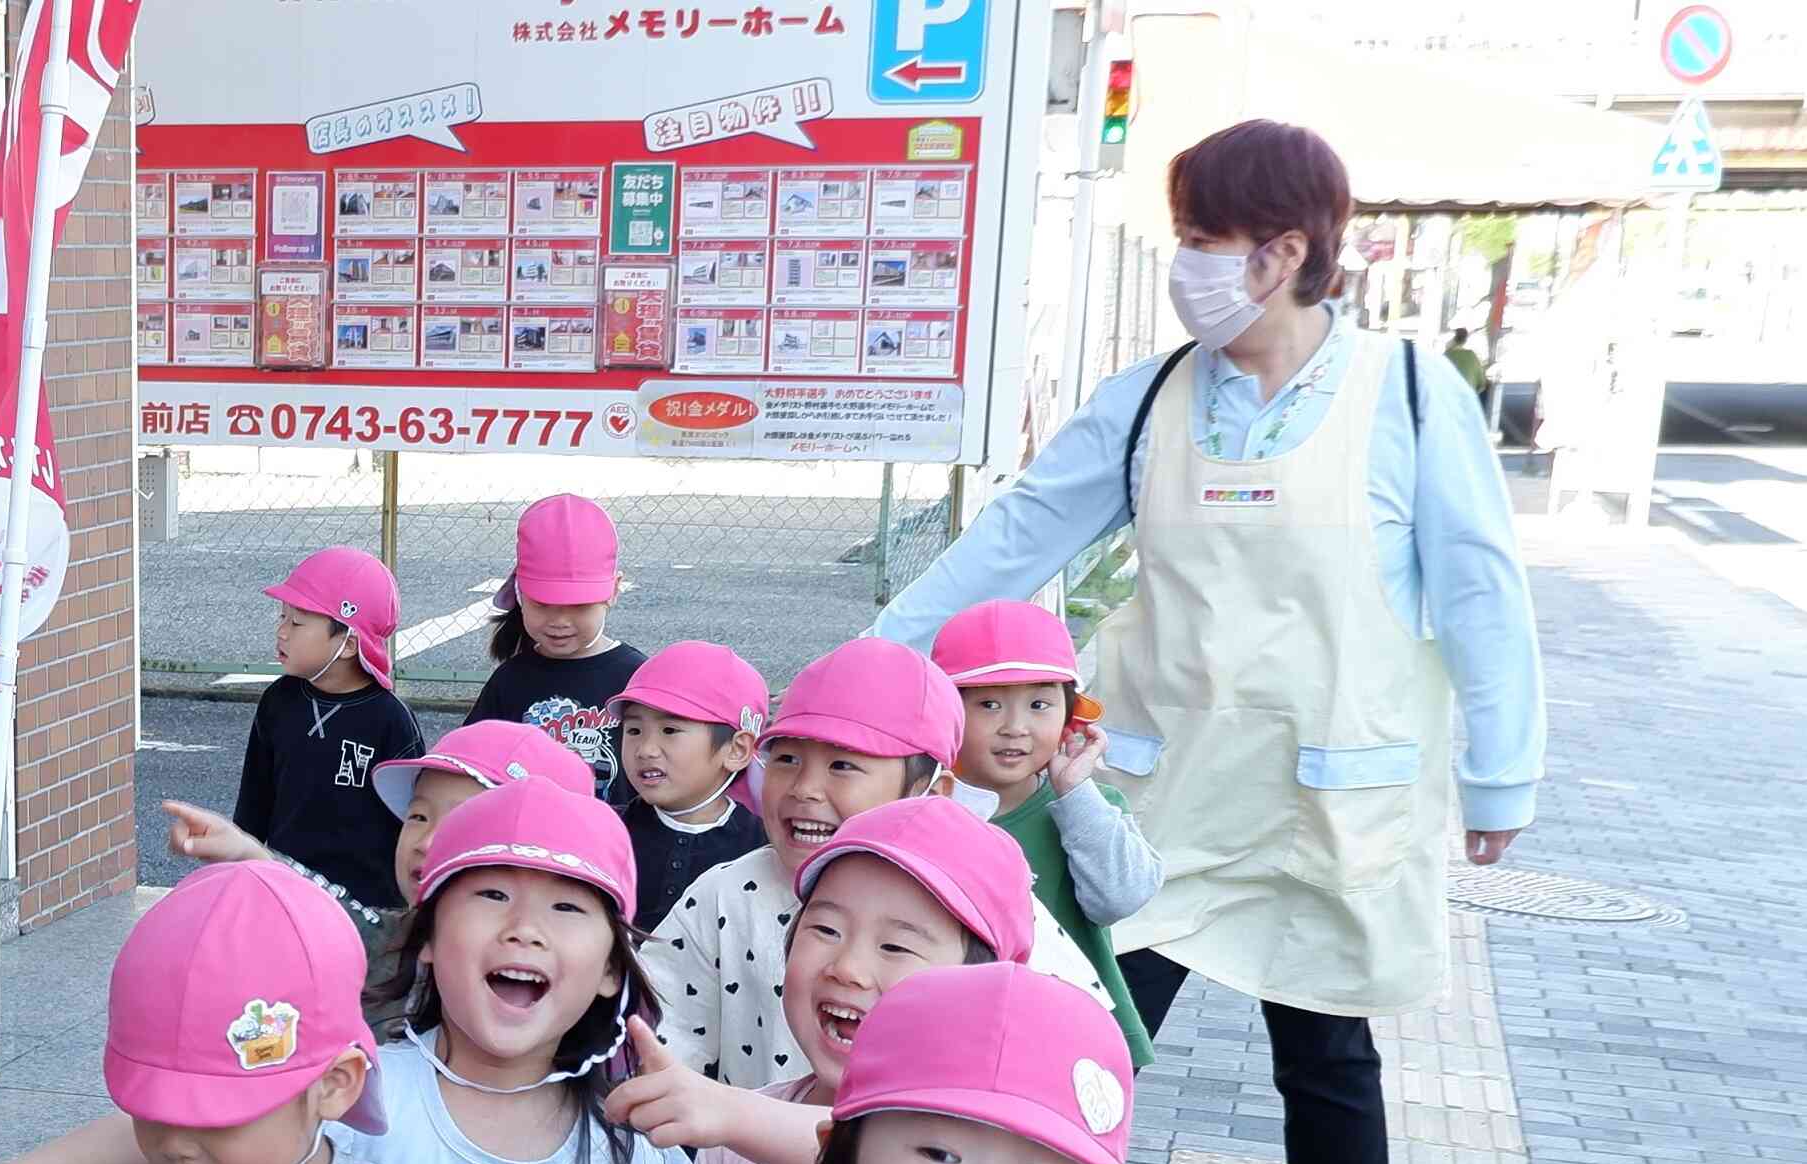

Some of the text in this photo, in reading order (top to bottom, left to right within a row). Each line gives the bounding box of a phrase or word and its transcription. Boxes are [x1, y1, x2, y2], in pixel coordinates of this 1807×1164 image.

[895, 0, 969, 51] P
[622, 174, 664, 190] 友だち
[622, 191, 664, 207] 募集中
[142, 403, 594, 447] 前店 0743-63-7777
[572, 732, 599, 746] YEAH!
[335, 739, 374, 787] N
